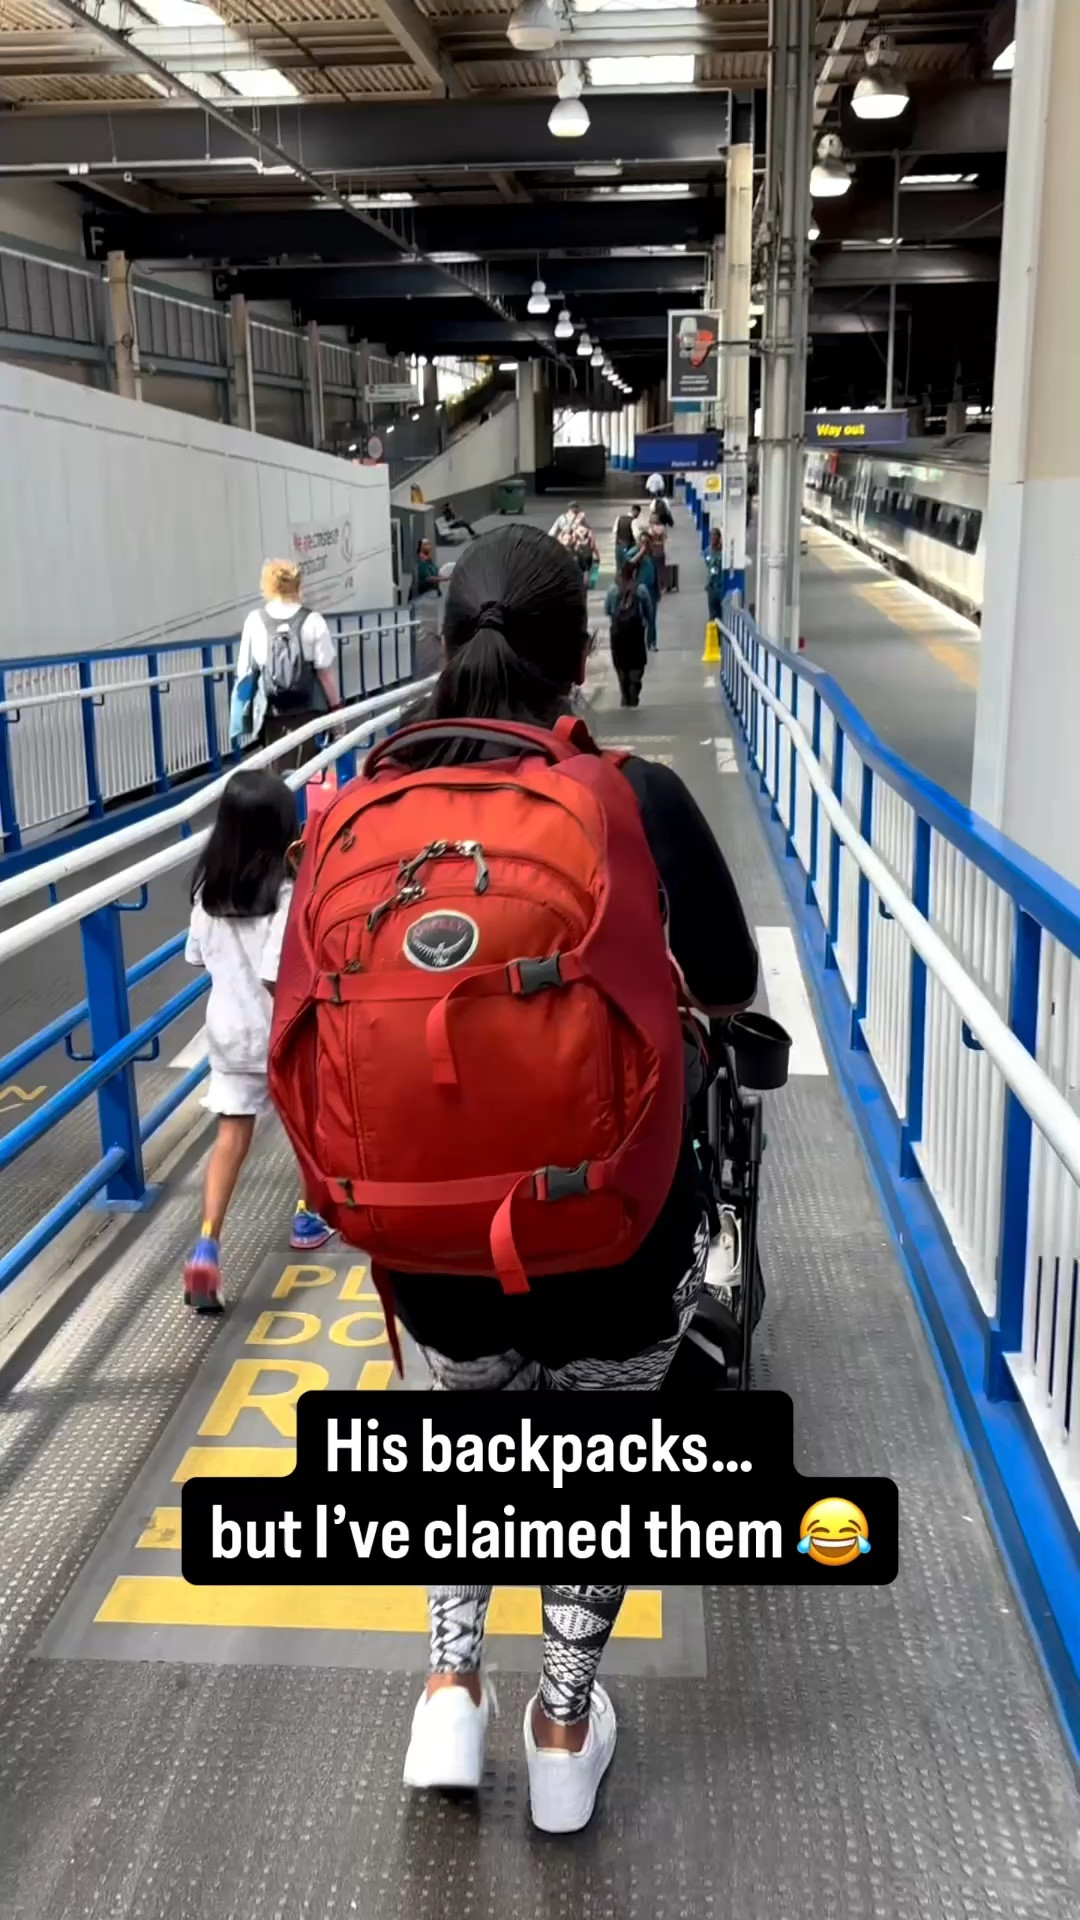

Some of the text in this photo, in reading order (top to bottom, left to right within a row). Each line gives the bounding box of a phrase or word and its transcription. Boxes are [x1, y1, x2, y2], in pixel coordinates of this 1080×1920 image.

[90, 226, 105, 254] F
[816, 424, 865, 438] Way out
[244, 1310, 402, 1347] DO
